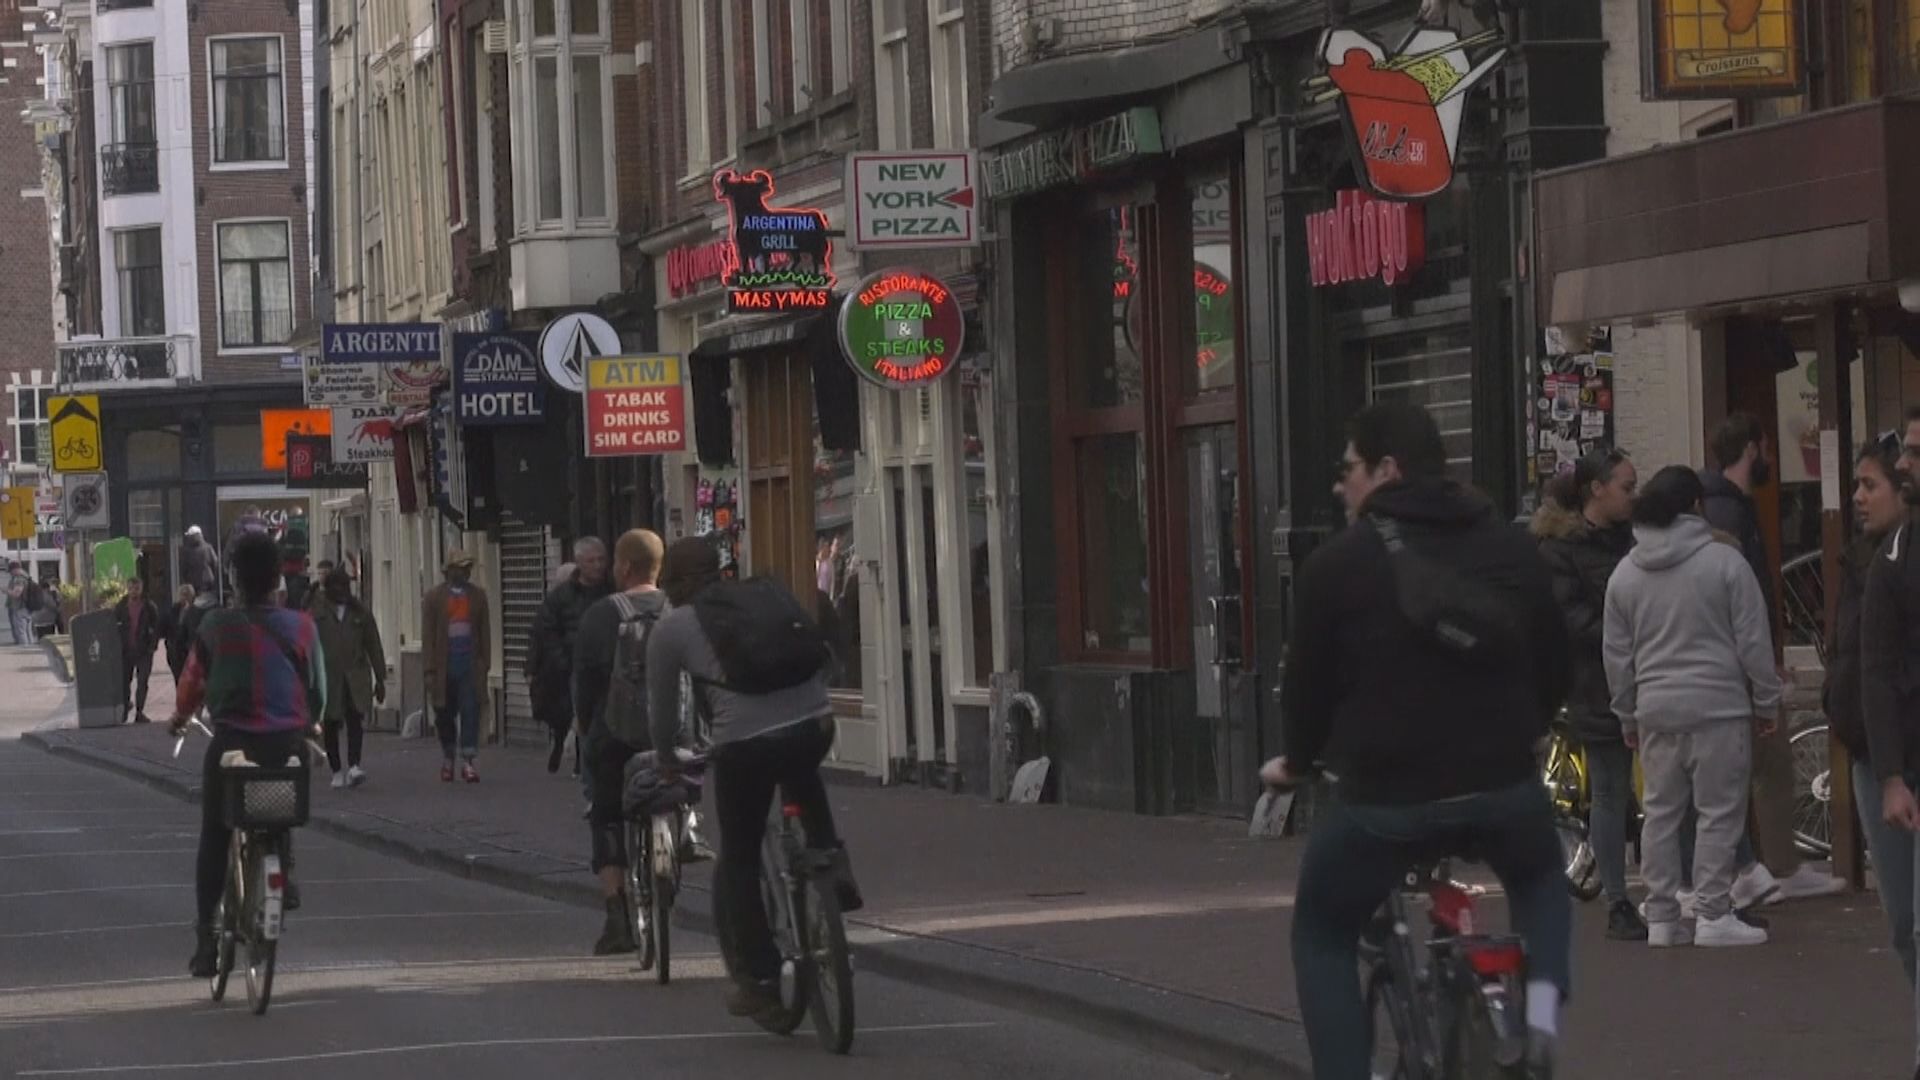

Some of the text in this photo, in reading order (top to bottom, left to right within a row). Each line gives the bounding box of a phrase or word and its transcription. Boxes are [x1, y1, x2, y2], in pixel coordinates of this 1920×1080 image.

[1695, 55, 1760, 75] Croissants
[1410, 141, 1424, 151] TO
[1410, 151, 1424, 162] GO
[878, 163, 946, 181] NEW
[865, 187, 958, 209] YORK
[743, 216, 816, 230] ARGENTINA
[872, 217, 961, 236] PIZZA
[761, 235, 798, 249] GRILL
[859, 272, 947, 306] RISTORANTE
[734, 290, 827, 309] MAS Y MAS
[875, 302, 932, 320] PIZZA
[898, 321, 911, 336] &
[329, 331, 440, 353] ARGENTI
[866, 338, 945, 357] STEAKS
[478, 346, 522, 372] DAM
[480, 371, 520, 382] STRAAT
[605, 361, 665, 384] ATM
[874, 356, 942, 381] ITALIANO
[461, 392, 542, 416] HOTEL
[604, 391, 667, 407] TABAK
[603, 410, 671, 427] DRINKS
[595, 430, 681, 447] SIM CARD
[313, 462, 365, 475] PLAZA
